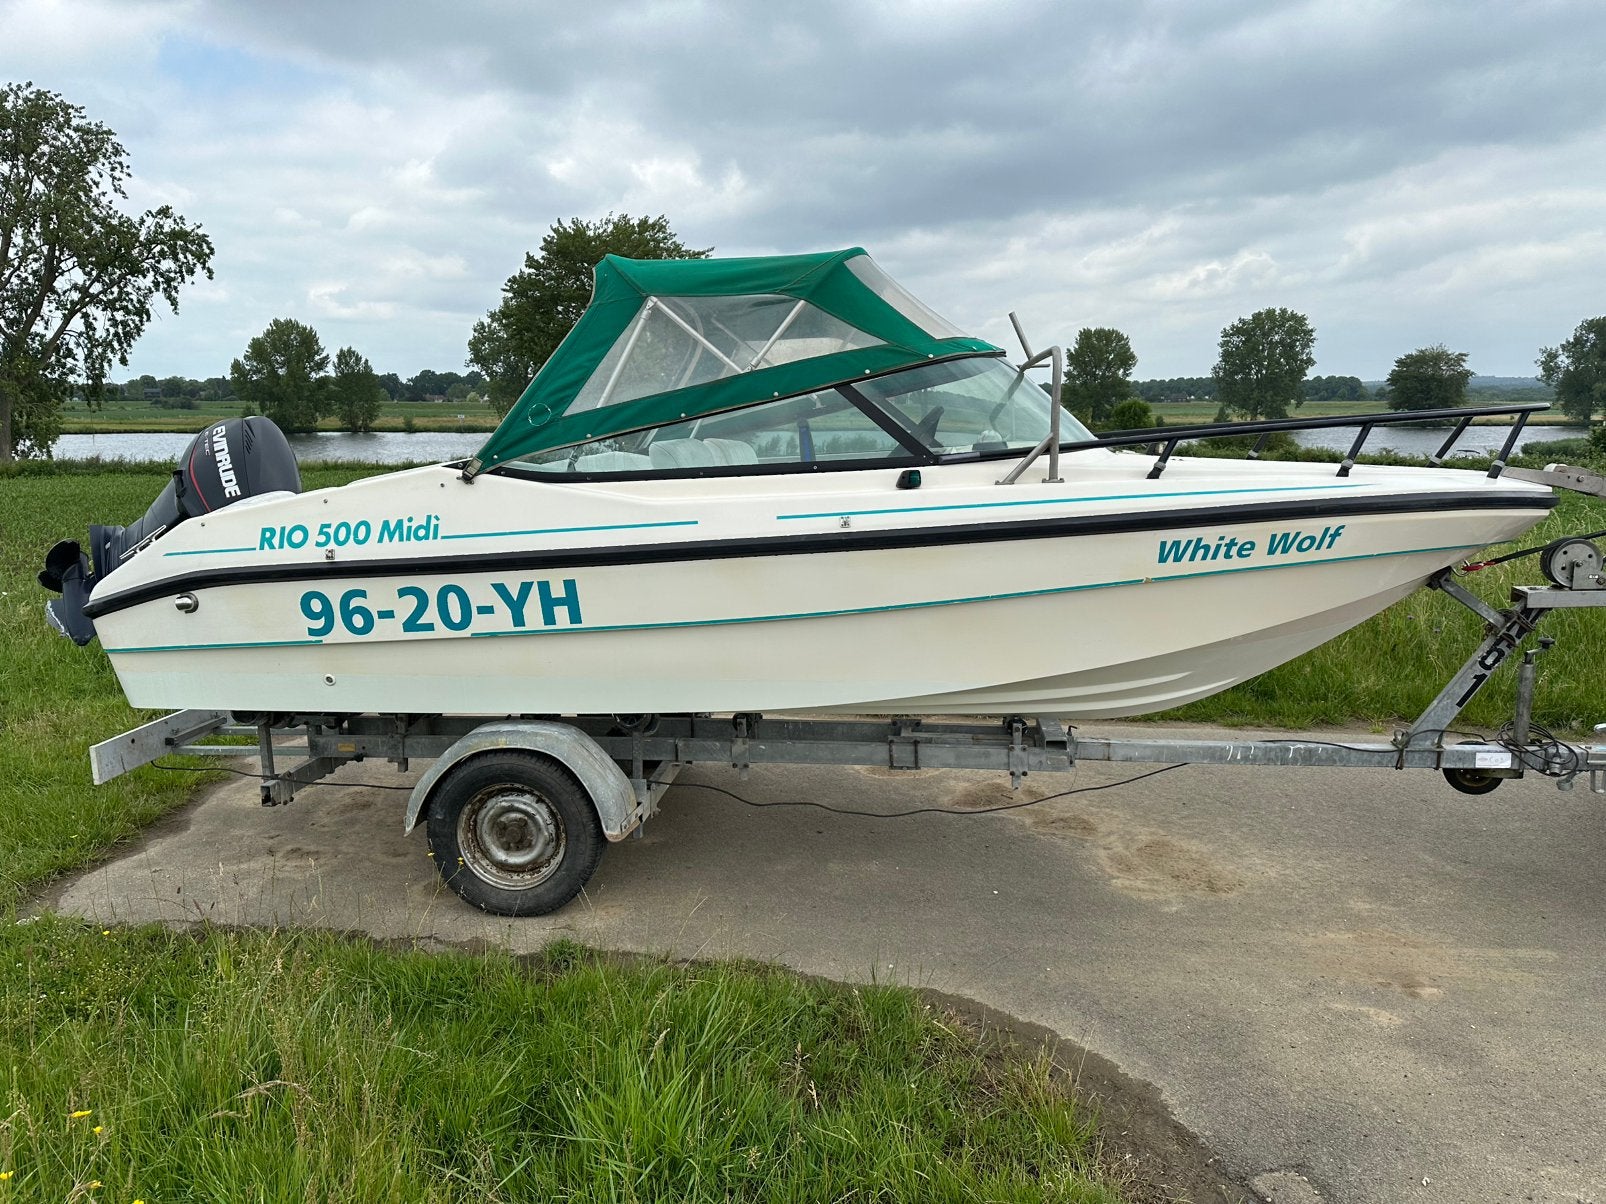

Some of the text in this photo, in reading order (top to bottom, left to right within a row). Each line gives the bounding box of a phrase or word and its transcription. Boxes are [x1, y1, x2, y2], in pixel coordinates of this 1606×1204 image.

[213, 425, 241, 498] EVINRUDE
[259, 524, 309, 551] RIO
[315, 520, 371, 548] 500
[1158, 525, 1346, 564] White Wolf
[300, 578, 583, 637] 96-20-YH
